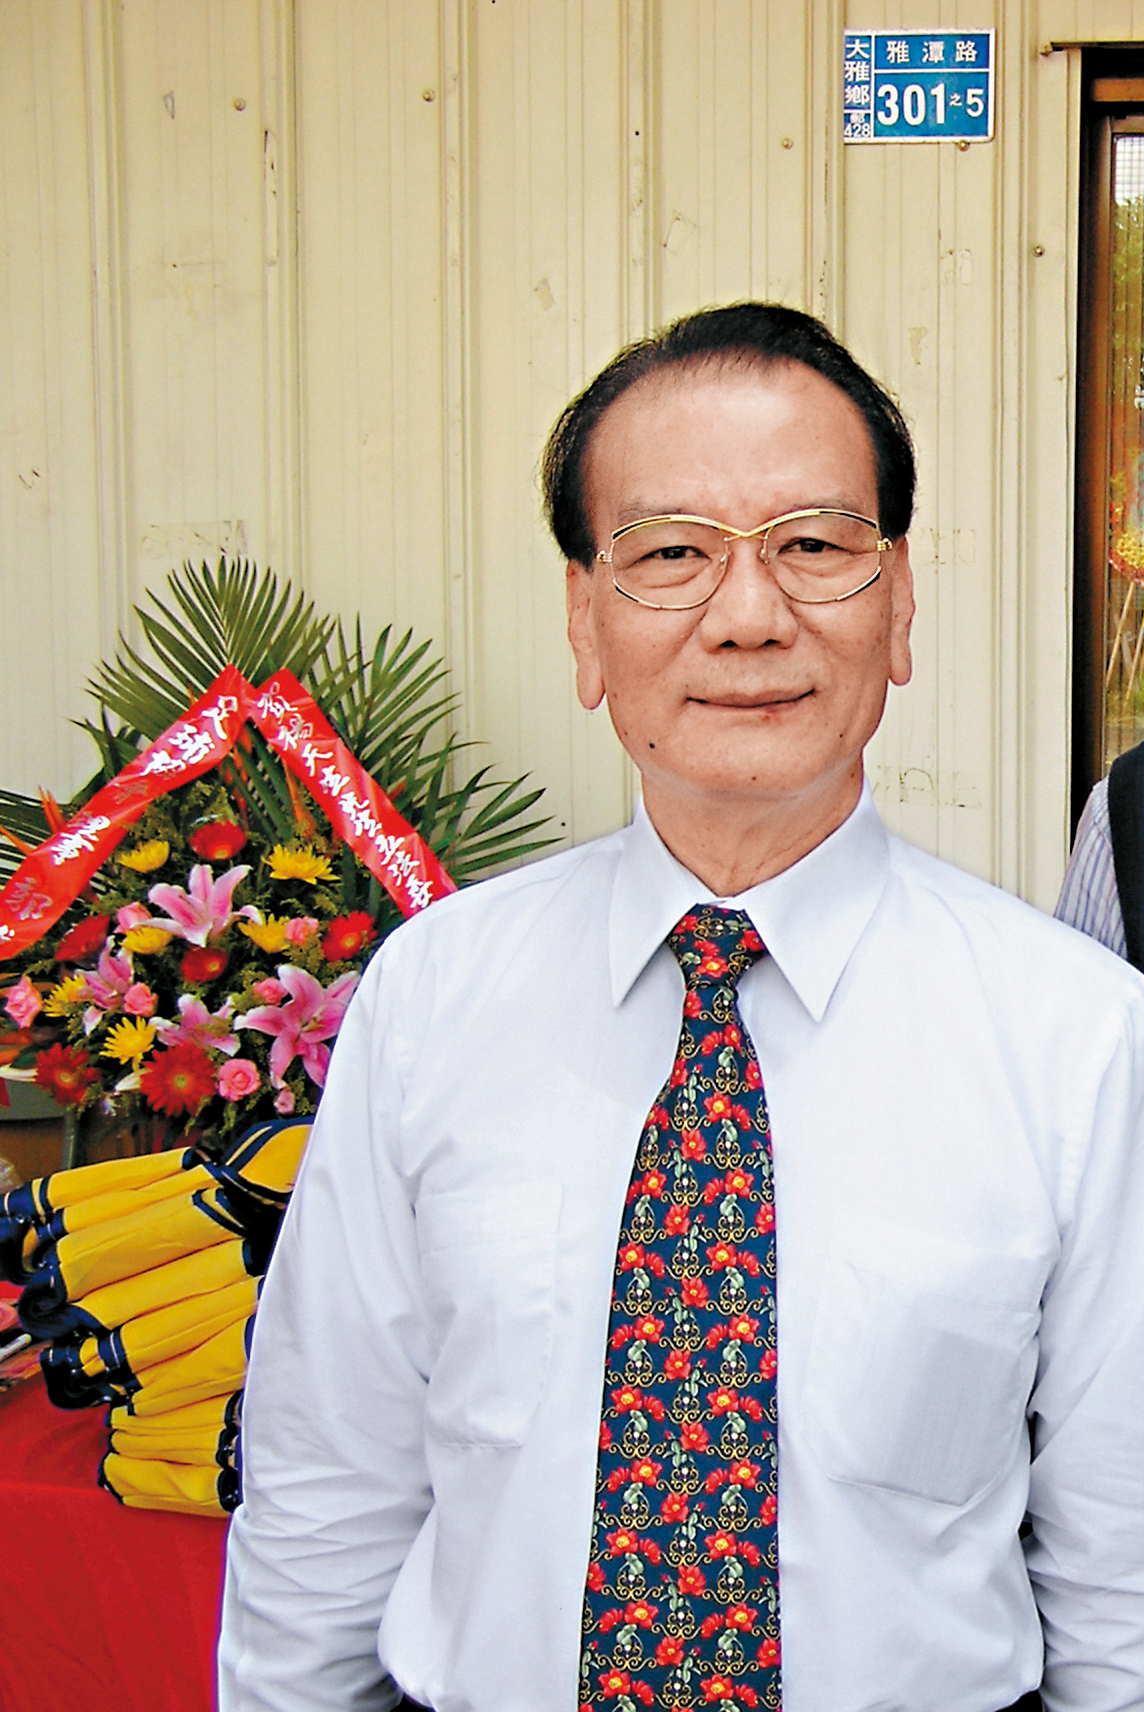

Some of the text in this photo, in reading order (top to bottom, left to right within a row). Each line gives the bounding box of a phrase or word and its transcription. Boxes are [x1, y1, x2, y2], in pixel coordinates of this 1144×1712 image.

[886, 40, 977, 63] 雅潭路
[845, 39, 870, 105] 大雅鄉
[844, 123, 871, 137] 428
